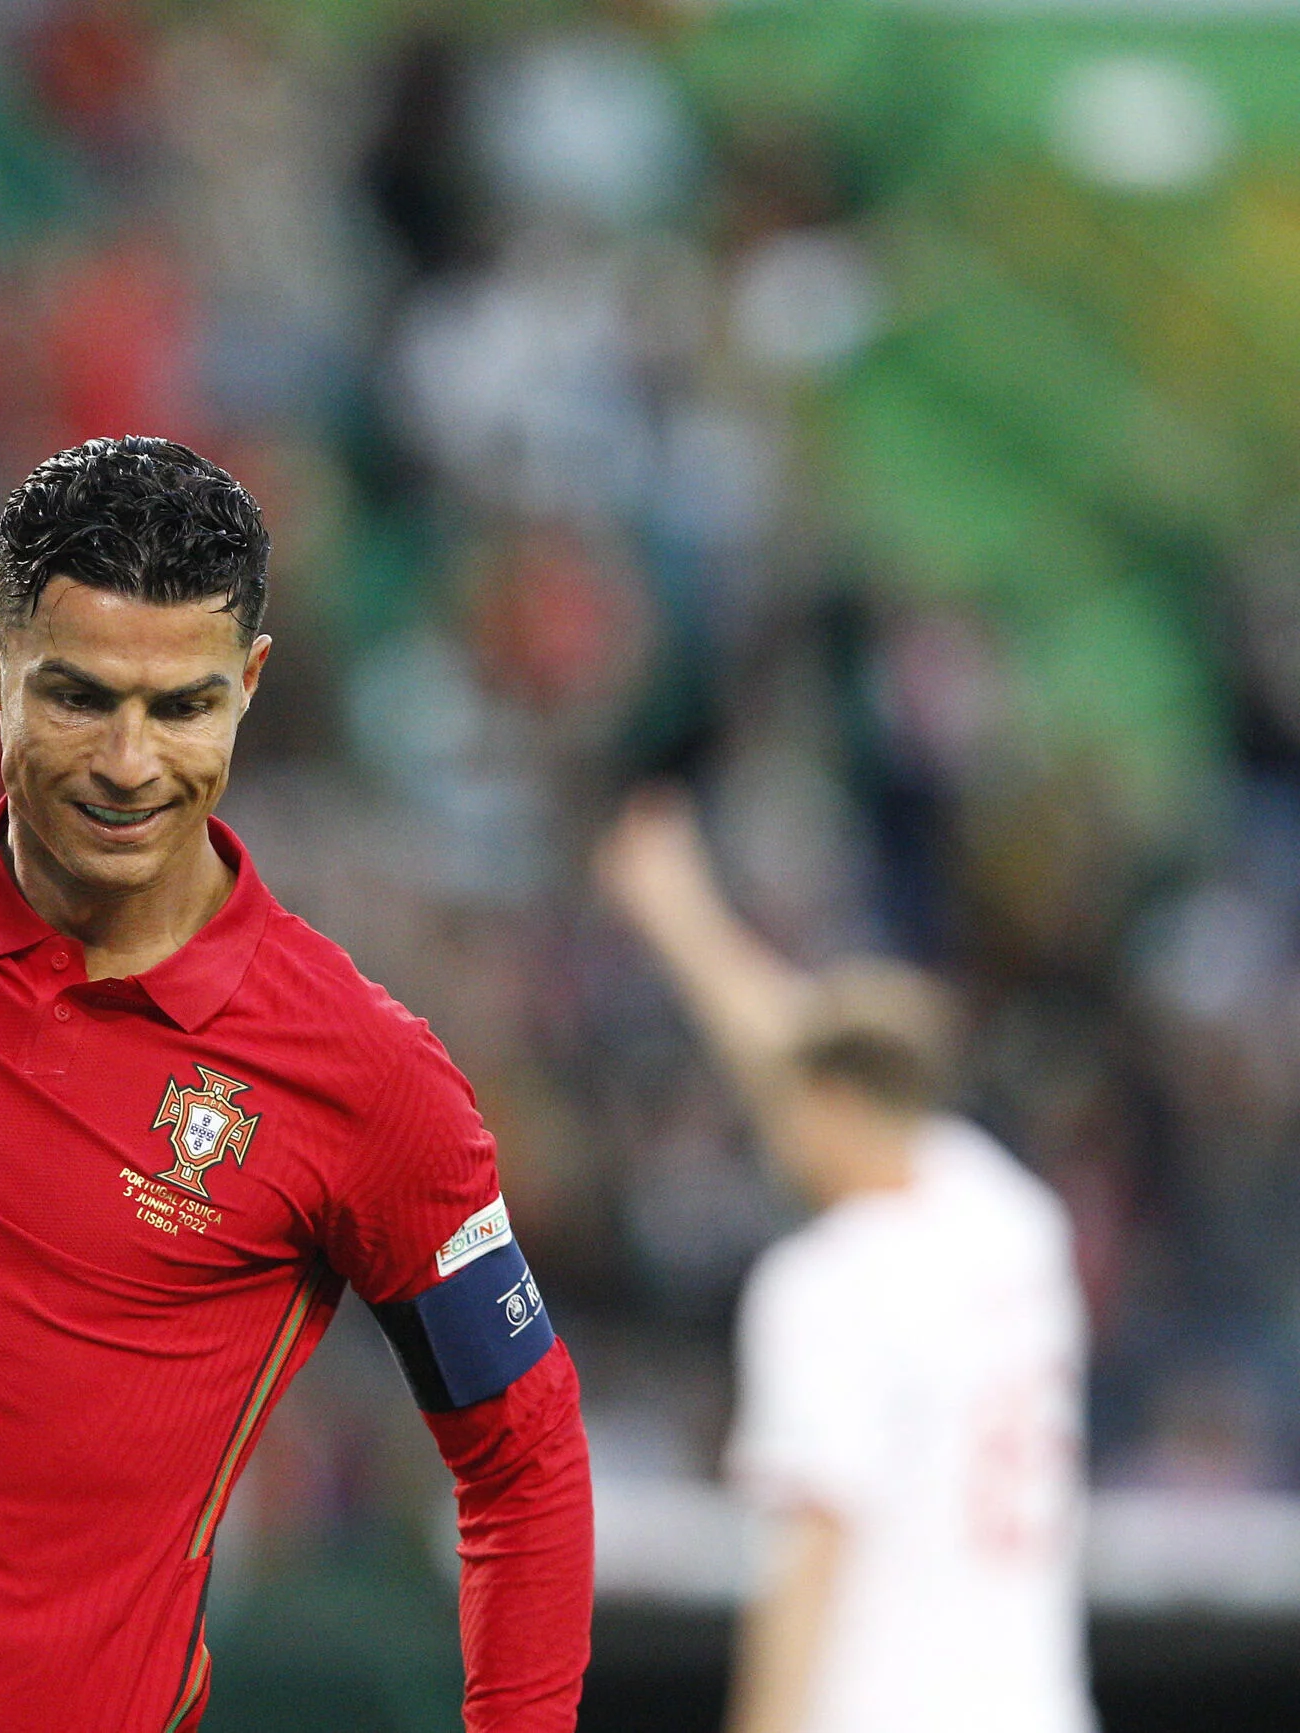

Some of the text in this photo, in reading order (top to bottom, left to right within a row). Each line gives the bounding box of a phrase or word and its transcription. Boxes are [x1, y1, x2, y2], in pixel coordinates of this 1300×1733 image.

[123, 1186, 208, 1234] 5 JUNHO 2022
[136, 1207, 179, 1237] LISBOA
